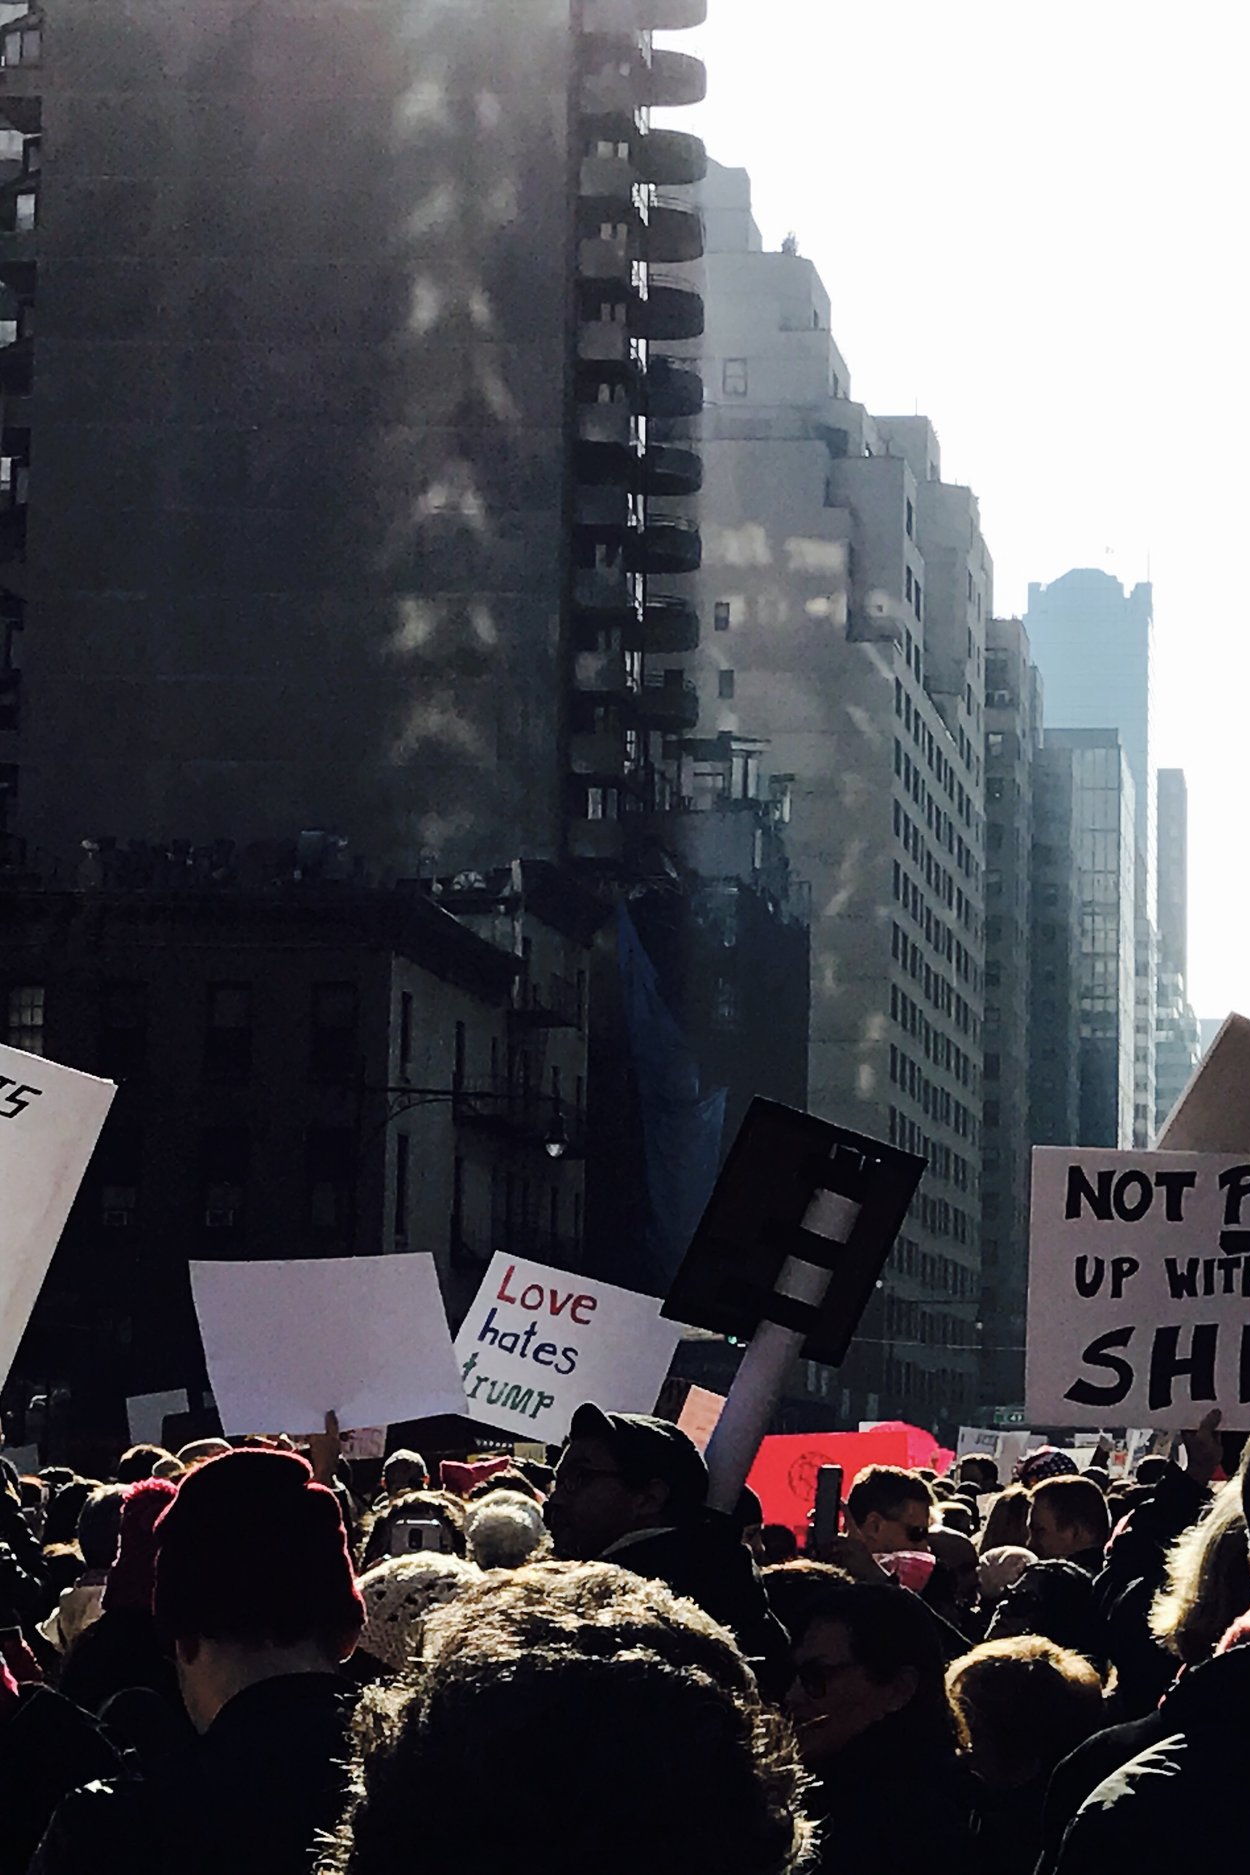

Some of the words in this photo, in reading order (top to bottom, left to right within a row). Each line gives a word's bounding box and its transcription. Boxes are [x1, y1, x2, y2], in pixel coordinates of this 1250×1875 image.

[1064, 1165, 1197, 1222] NOT
[497, 1265, 598, 1325] Love
[1075, 1254, 1139, 1299] UP
[477, 1307, 579, 1375] hates
